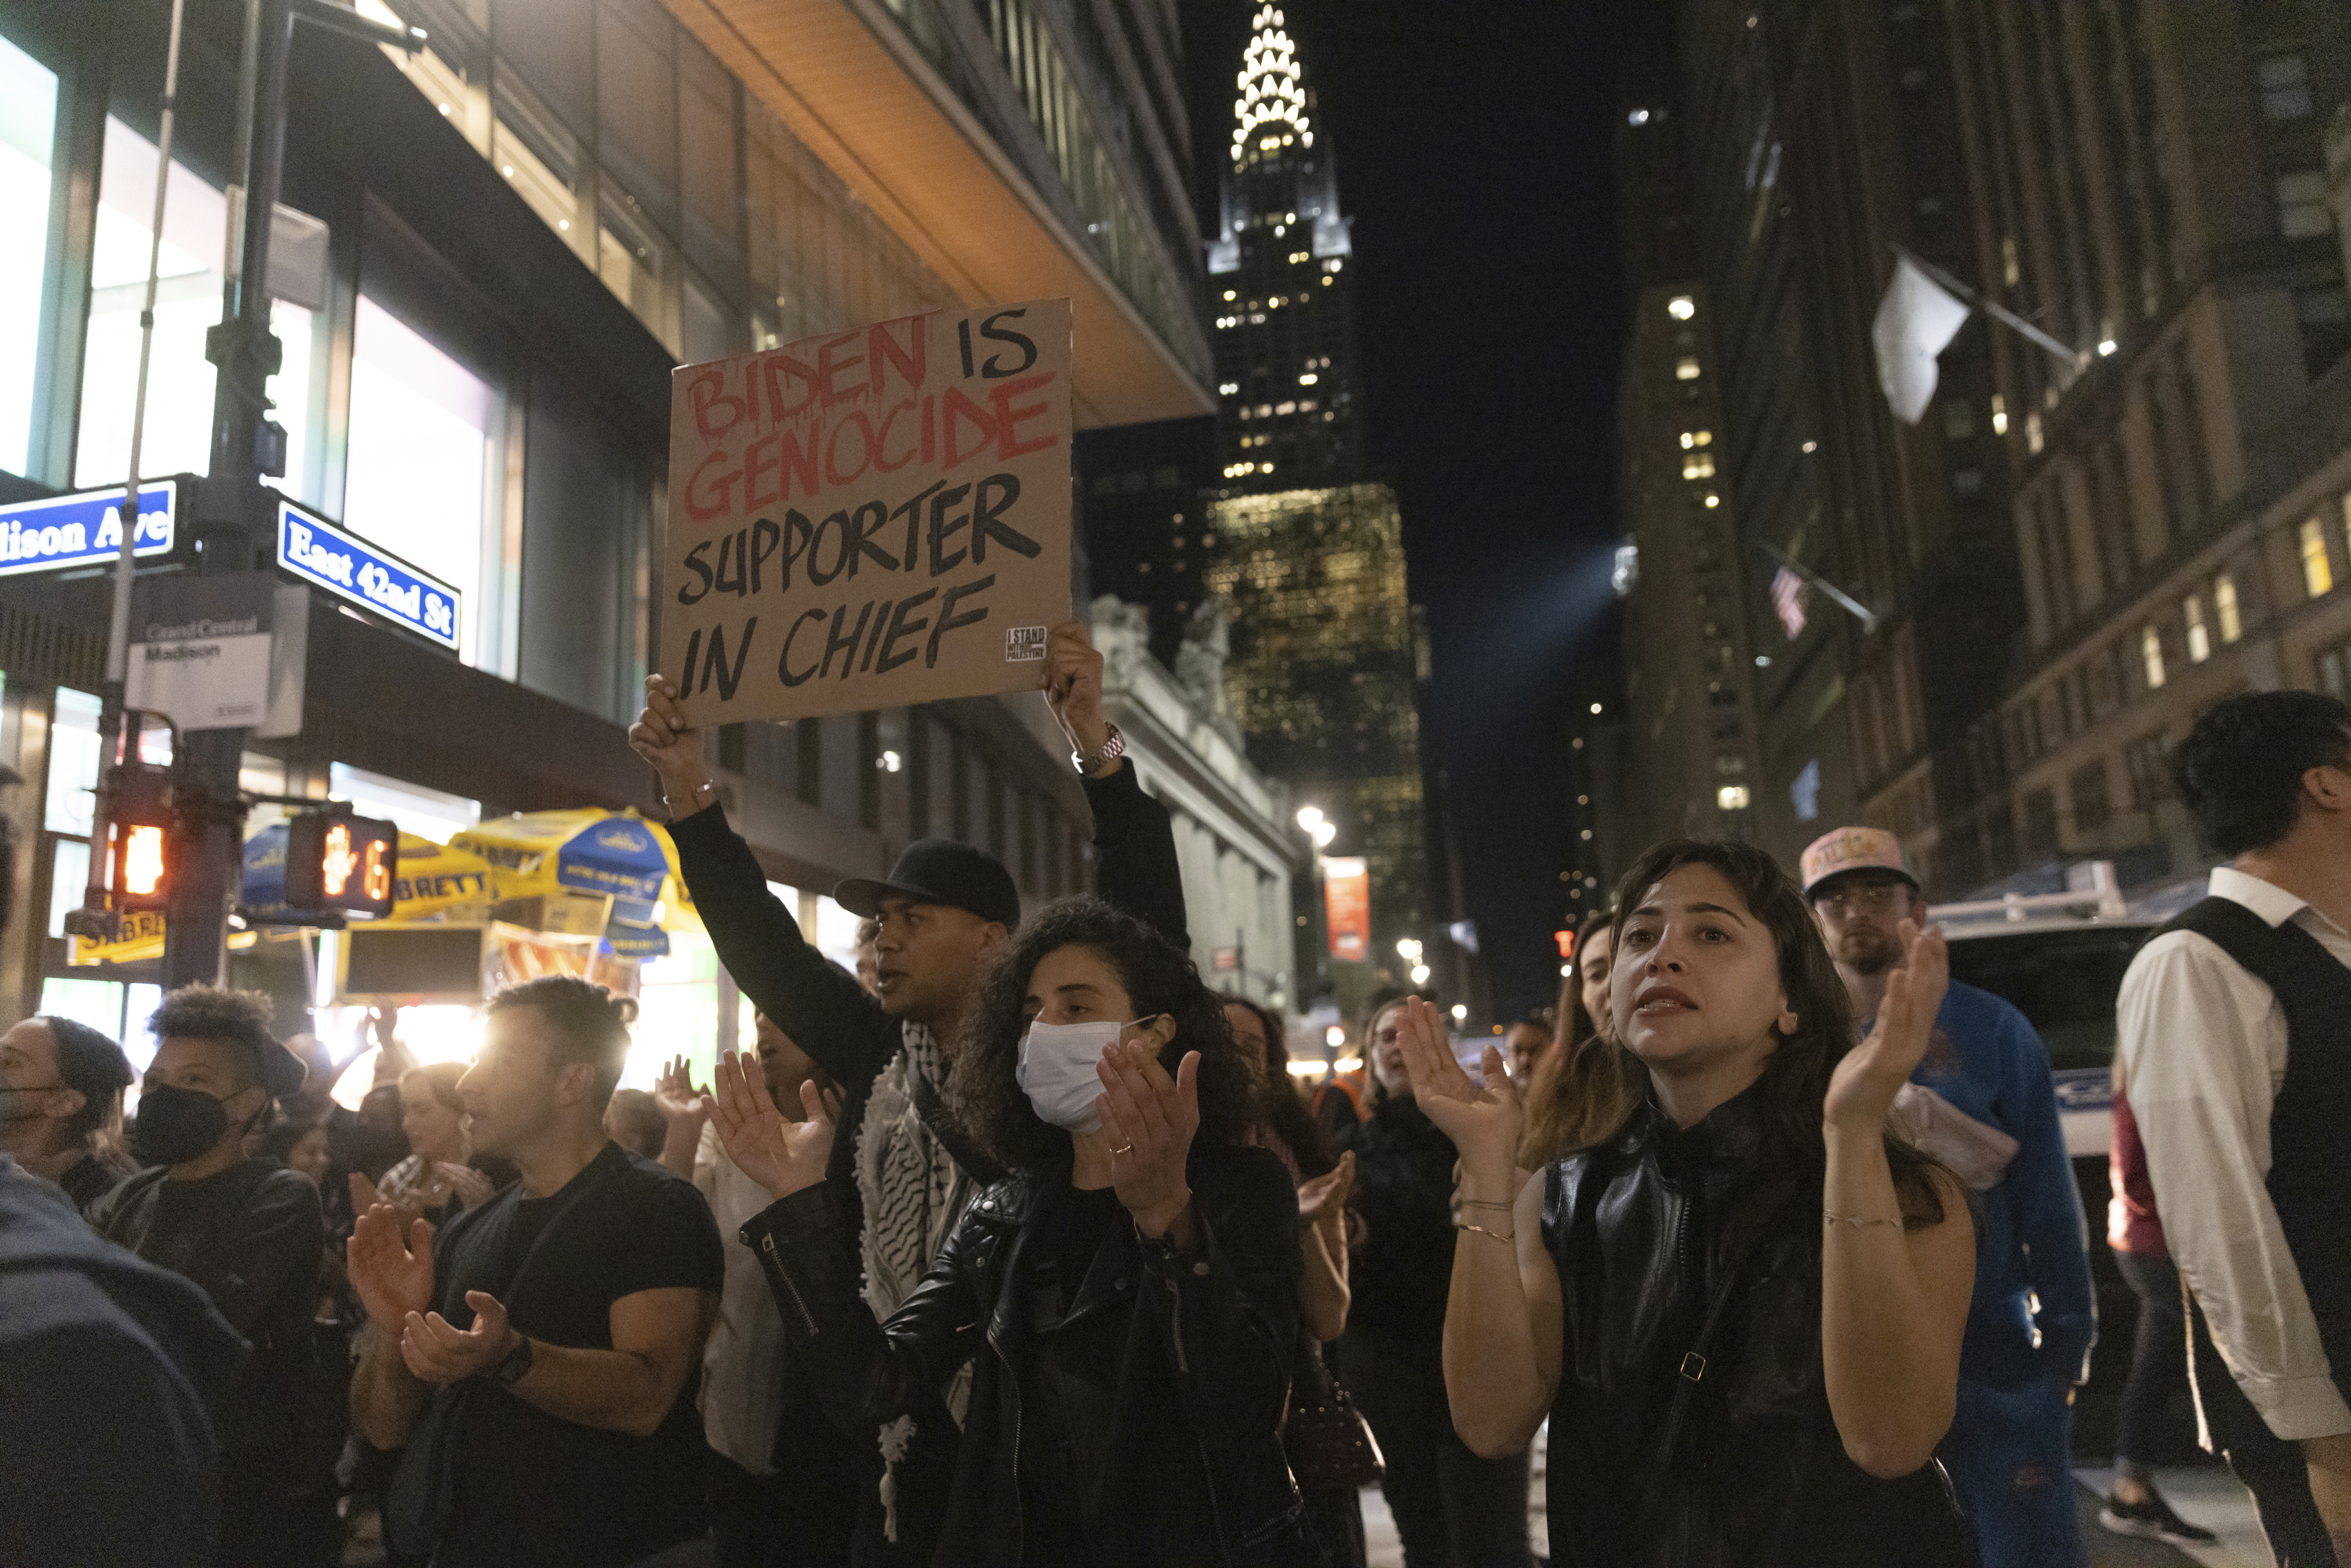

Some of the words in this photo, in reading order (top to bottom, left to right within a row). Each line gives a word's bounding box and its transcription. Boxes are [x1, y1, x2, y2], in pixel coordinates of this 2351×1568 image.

[687, 316, 927, 442] BIDEN
[958, 308, 1037, 378] IS
[683, 372, 1059, 522] GENOCIDE
[288, 521, 354, 587] East
[357, 562, 421, 620] 42nd
[424, 592, 452, 635] St
[678, 473, 1042, 605] SUPPORTER
[145, 644, 220, 662] Madison
[680, 616, 758, 701] IN
[779, 574, 996, 687] CHIEF
[1007, 647, 1044, 660] PALESTINE
[1014, 628, 1045, 644] STAND
